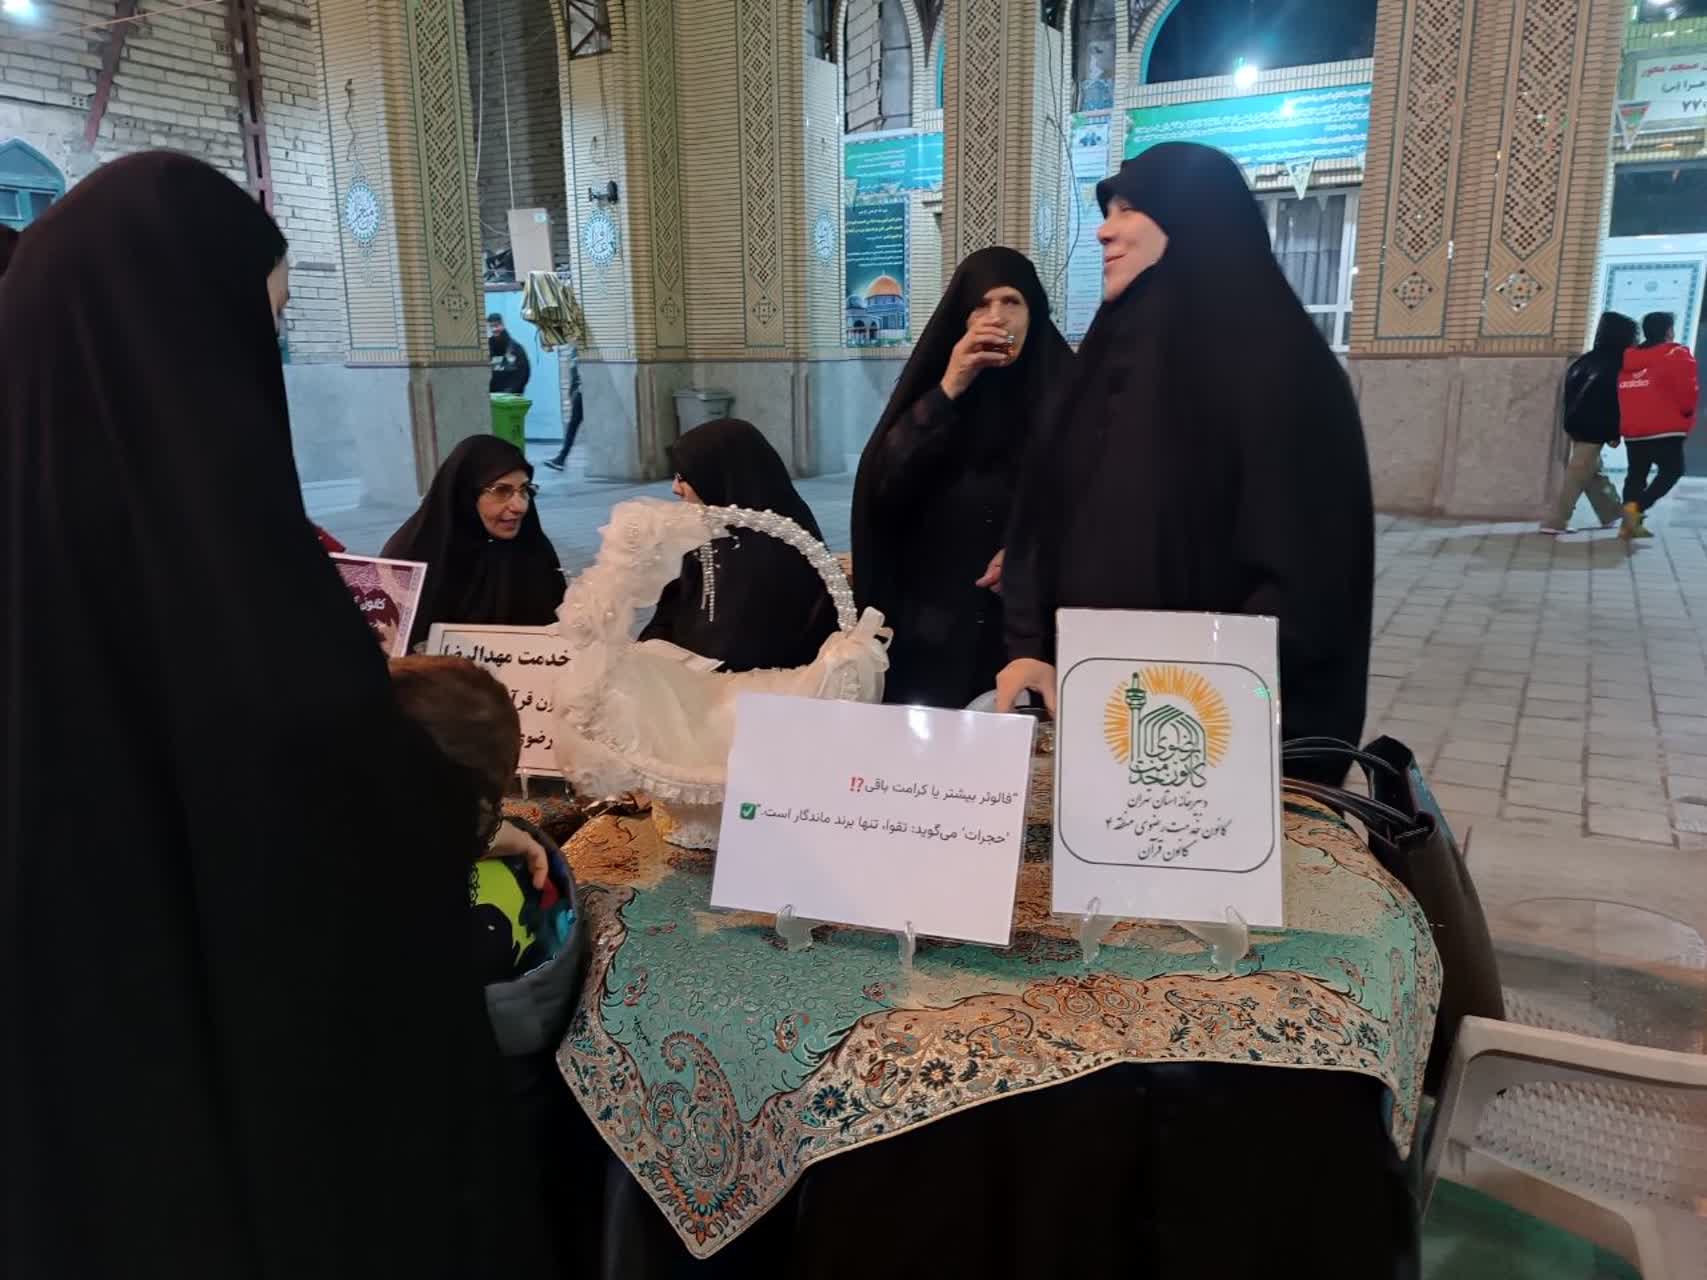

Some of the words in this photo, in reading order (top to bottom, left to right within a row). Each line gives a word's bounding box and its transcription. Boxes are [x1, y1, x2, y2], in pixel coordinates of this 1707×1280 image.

[518, 650, 572, 666] خدمت
[511, 688, 533, 711] قرآ
[892, 783, 928, 798] کرامت
[931, 784, 940, 799] یا
[943, 788, 977, 803] بیشتر
[1127, 788, 1152, 808] تهران
[1152, 789, 1178, 809] استان
[793, 808, 831, 824] ماندگار
[834, 815, 855, 830] برند
[858, 815, 879, 831] تنها
[1134, 814, 1165, 836] رضوی
[1165, 818, 1201, 835] خدمت
[1201, 817, 1232, 839] کانون
[1137, 838, 1163, 861] قرآن
[1162, 838, 1198, 862] کانون
